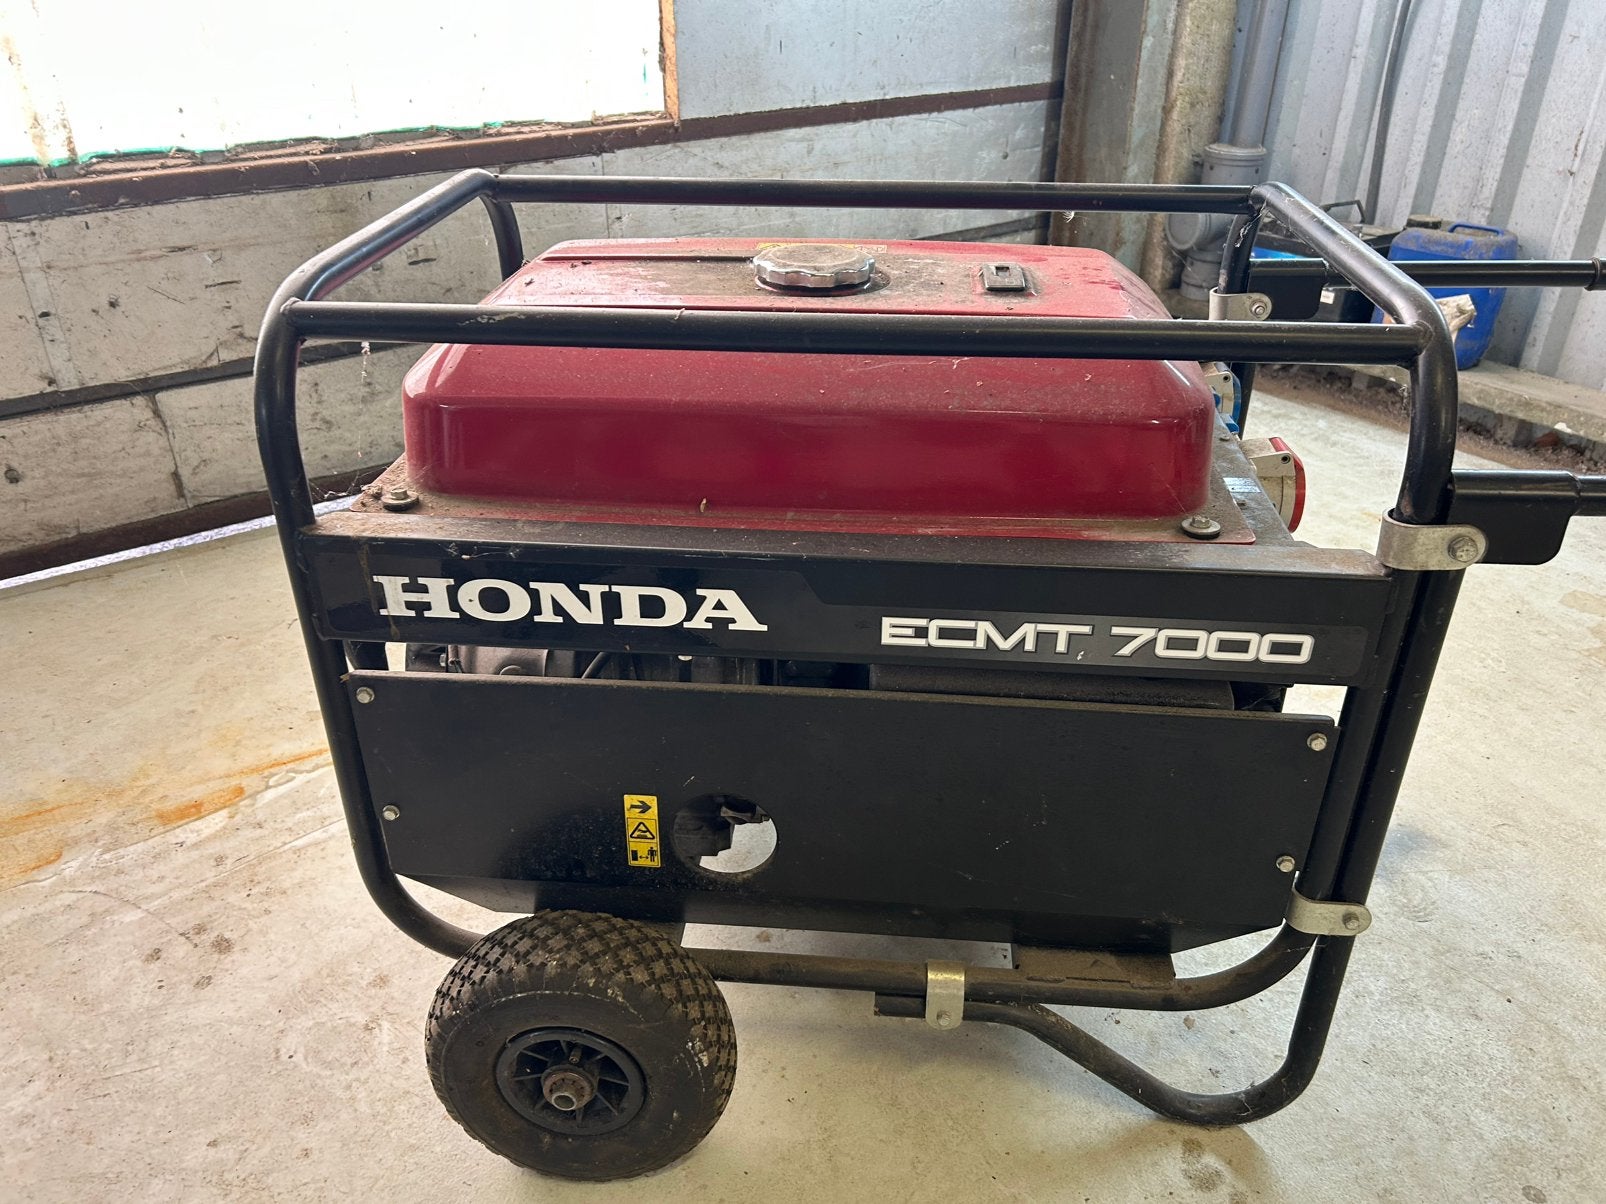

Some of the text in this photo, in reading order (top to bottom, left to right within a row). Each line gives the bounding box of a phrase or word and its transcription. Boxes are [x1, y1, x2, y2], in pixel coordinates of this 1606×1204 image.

[373, 575, 768, 632] HONDA
[881, 616, 1315, 664] ECMT 7000
